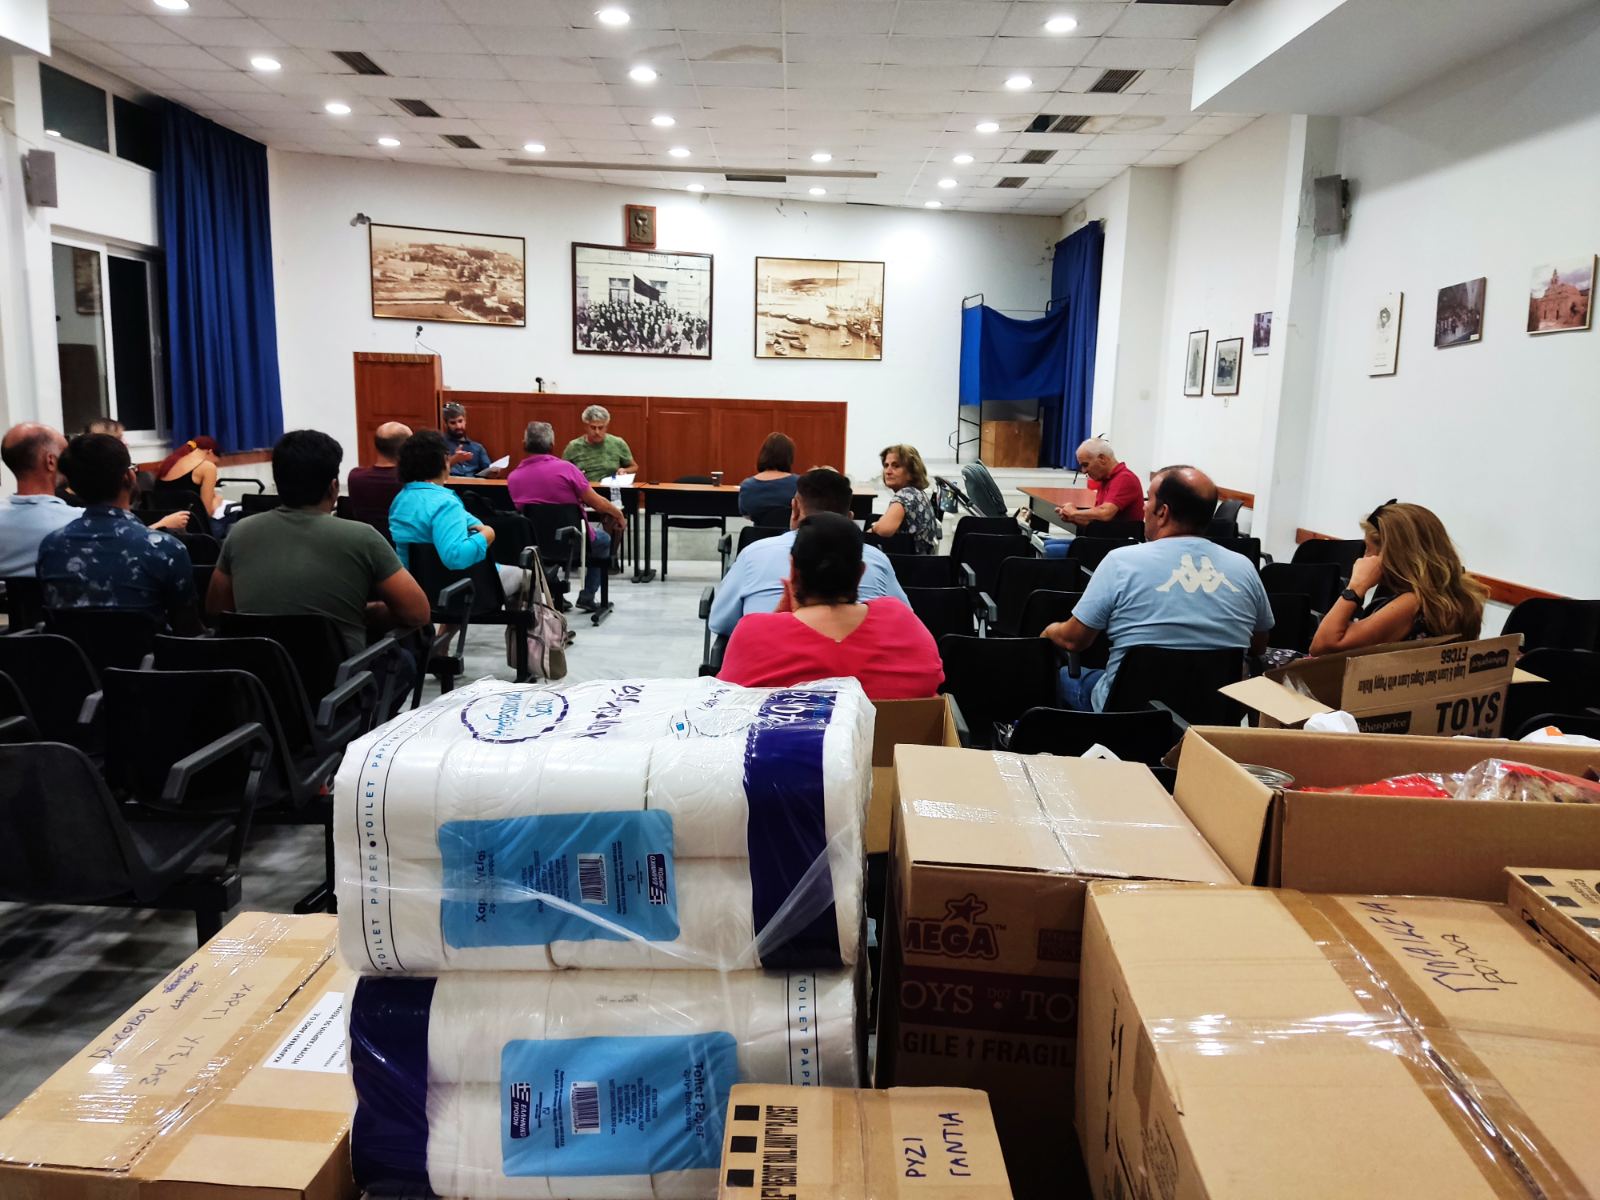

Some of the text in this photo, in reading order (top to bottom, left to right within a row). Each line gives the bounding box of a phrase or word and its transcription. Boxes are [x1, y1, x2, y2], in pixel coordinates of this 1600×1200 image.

[1436, 691, 1501, 734] TOYS
[366, 780, 376, 837] TOILET
[367, 853, 388, 966] TOILET PAPER
[901, 979, 975, 1015] OYS
[1020, 990, 1076, 1023] TO
[798, 978, 811, 1087] TOILET PAPE
[981, 1037, 1075, 1068] FRAGIL
[903, 1138, 927, 1178] ΡΥΖΙ
[938, 1112, 972, 1177] ΓΑΝΤΙΑ
